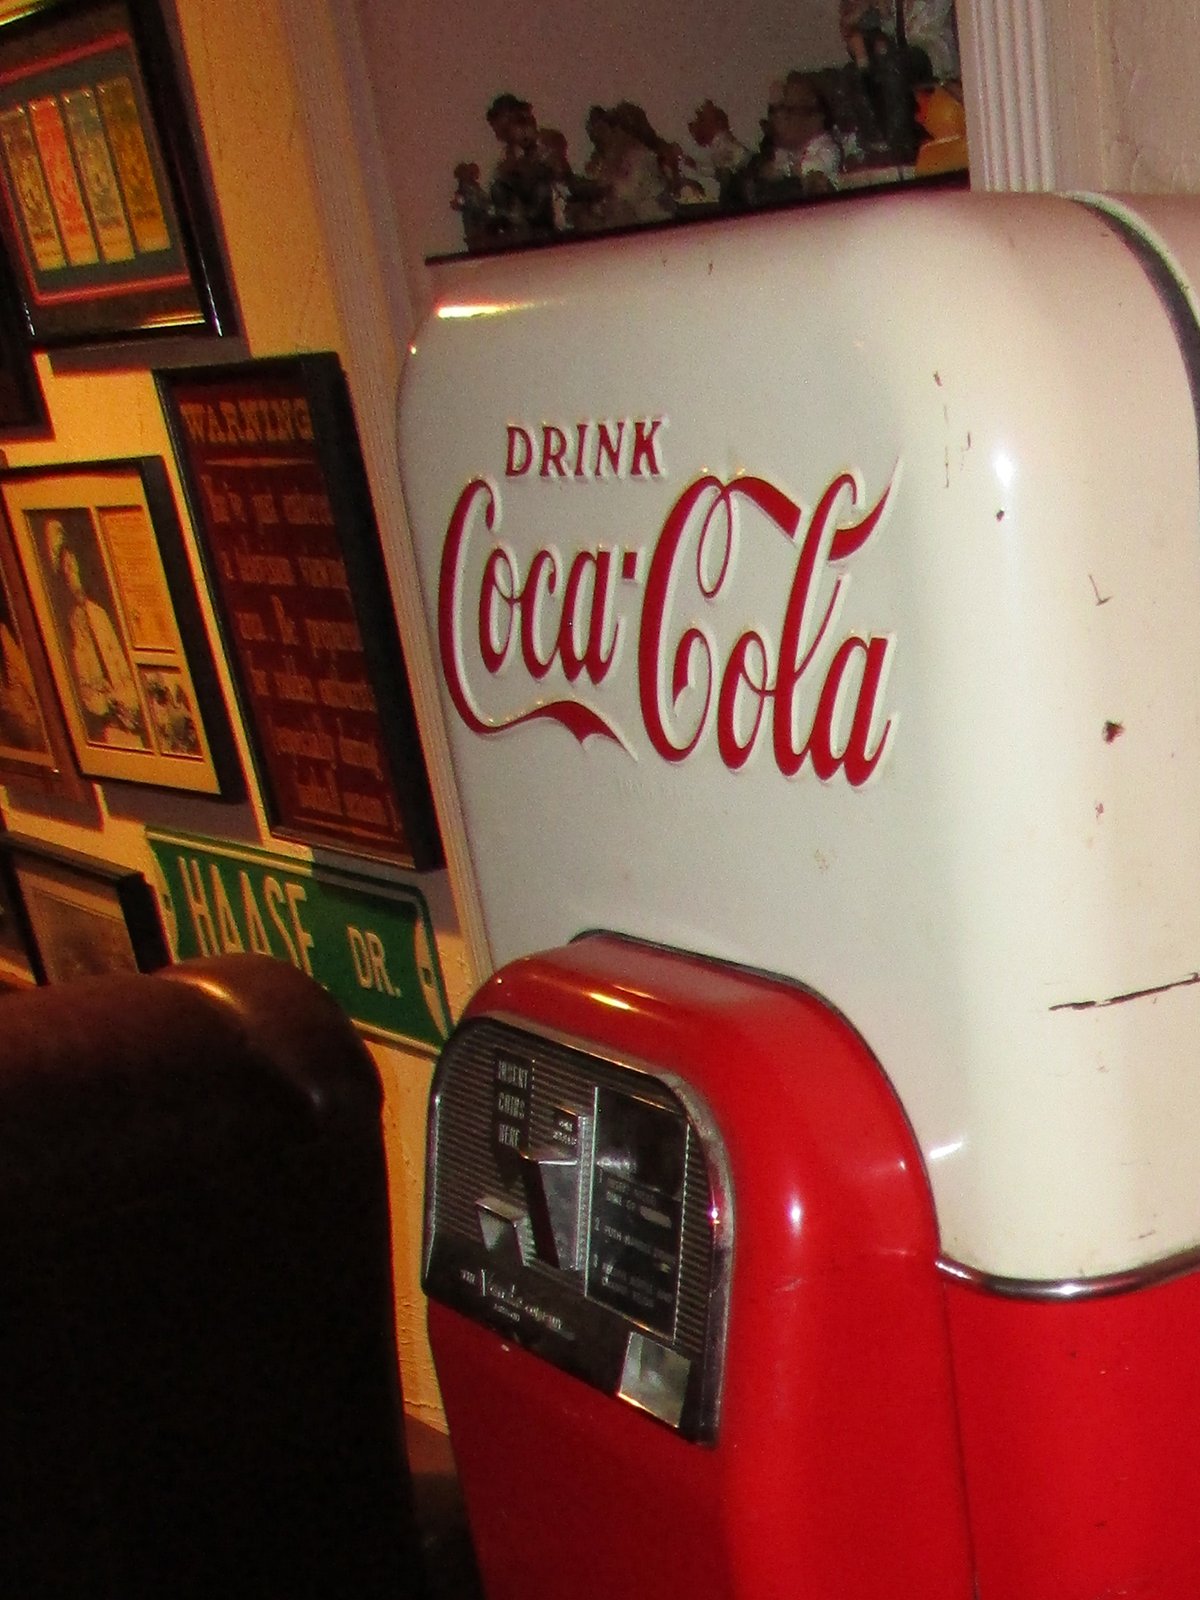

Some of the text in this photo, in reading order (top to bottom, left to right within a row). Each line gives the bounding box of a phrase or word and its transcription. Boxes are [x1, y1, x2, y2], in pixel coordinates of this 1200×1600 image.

[180, 398, 314, 444] WARNING
[505, 419, 664, 478] DRINK
[437, 456, 900, 787] Coca-Cola
[177, 855, 314, 978] HAASE
